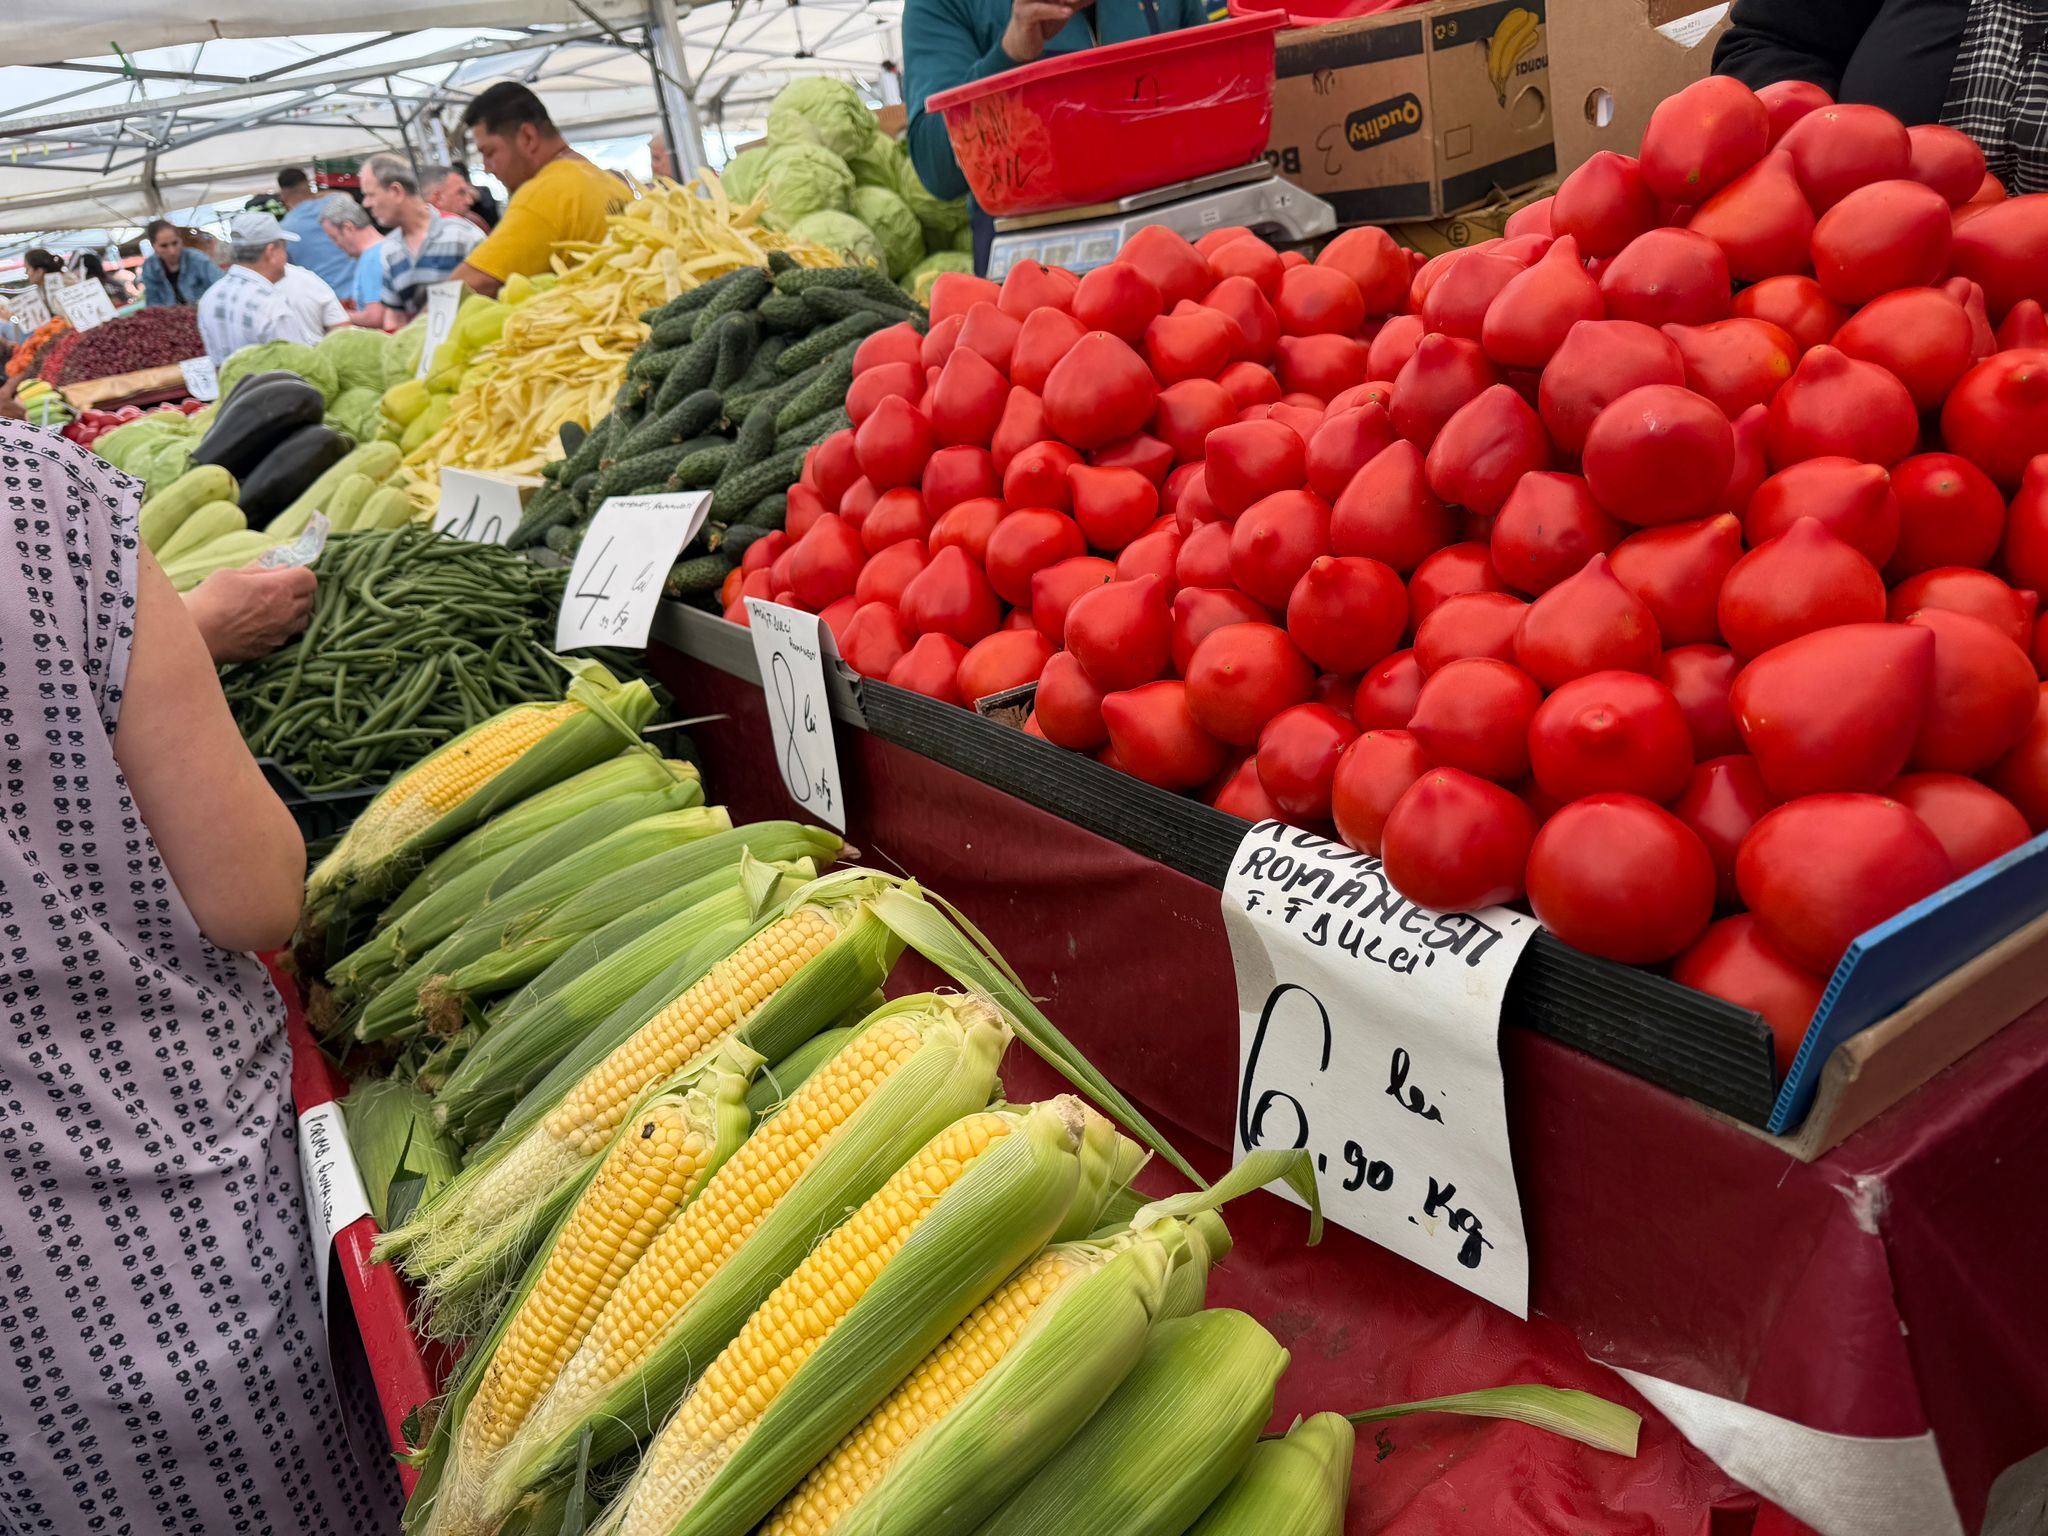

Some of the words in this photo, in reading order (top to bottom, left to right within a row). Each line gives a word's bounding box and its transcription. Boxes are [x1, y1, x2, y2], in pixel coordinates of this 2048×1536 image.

[1350, 100, 1419, 142] Quality
[575, 536, 618, 631] 4
[772, 651, 812, 803] 8
[1385, 1047, 1446, 1126] lei
